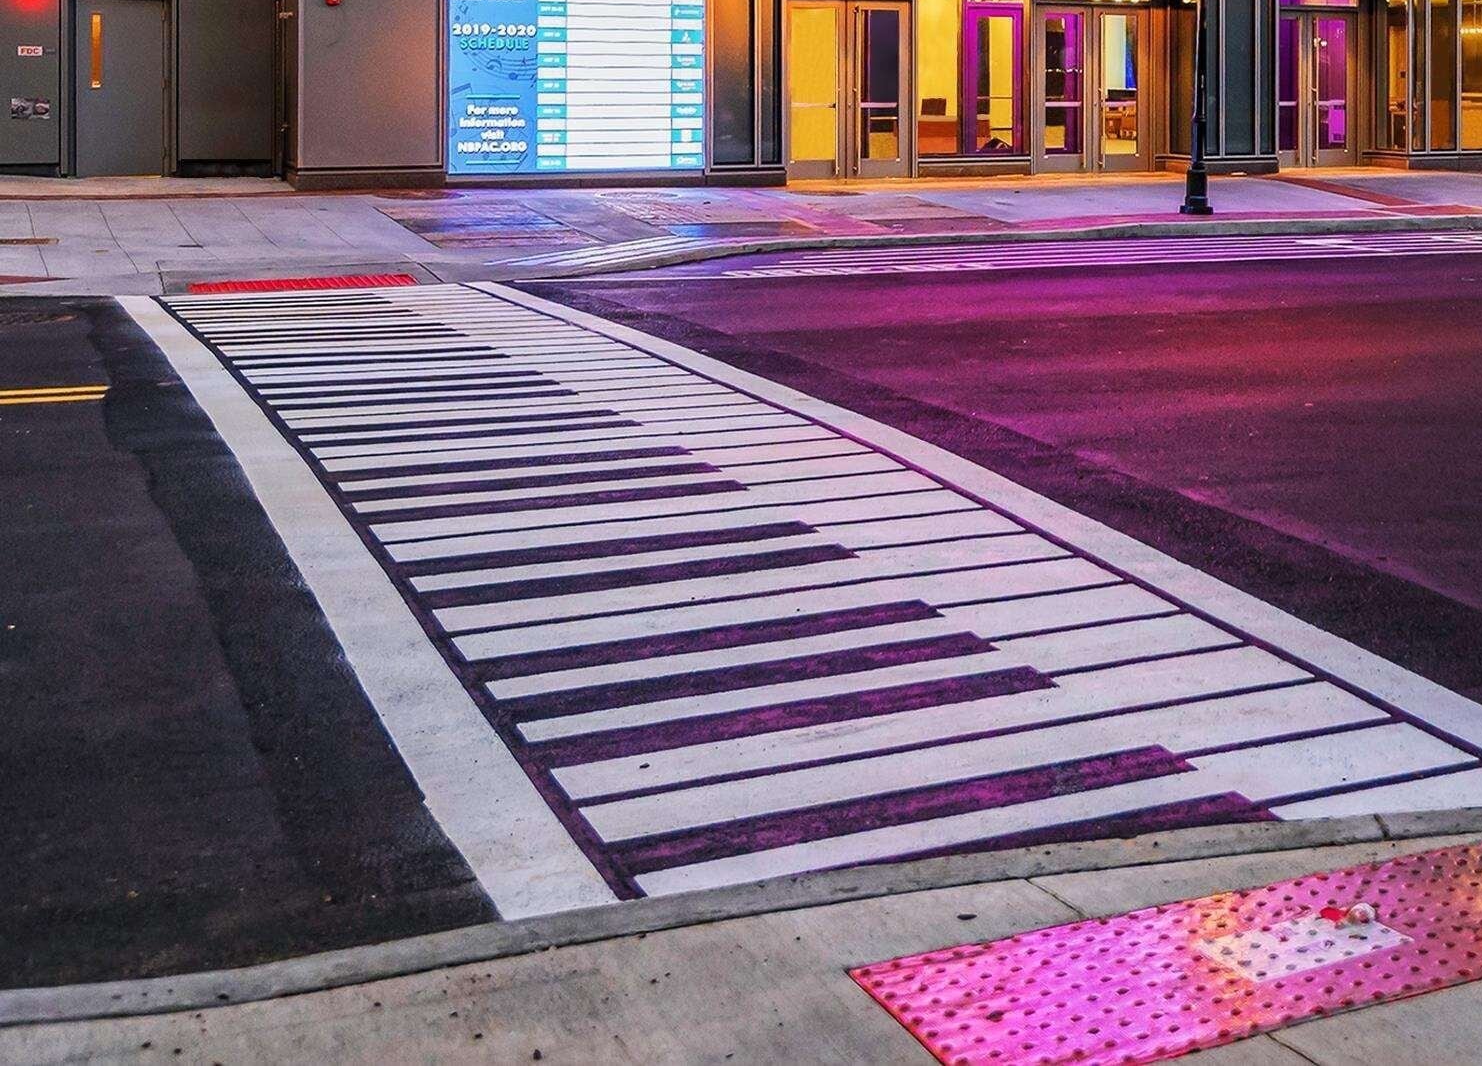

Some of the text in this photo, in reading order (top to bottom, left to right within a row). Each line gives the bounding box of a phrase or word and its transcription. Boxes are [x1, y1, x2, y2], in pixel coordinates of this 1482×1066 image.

[453, 23, 537, 36] 2019-2020
[460, 38, 529, 50] SCHEDULE
[467, 104, 519, 116] For more
[458, 141, 527, 153] NBPAC.ORG
